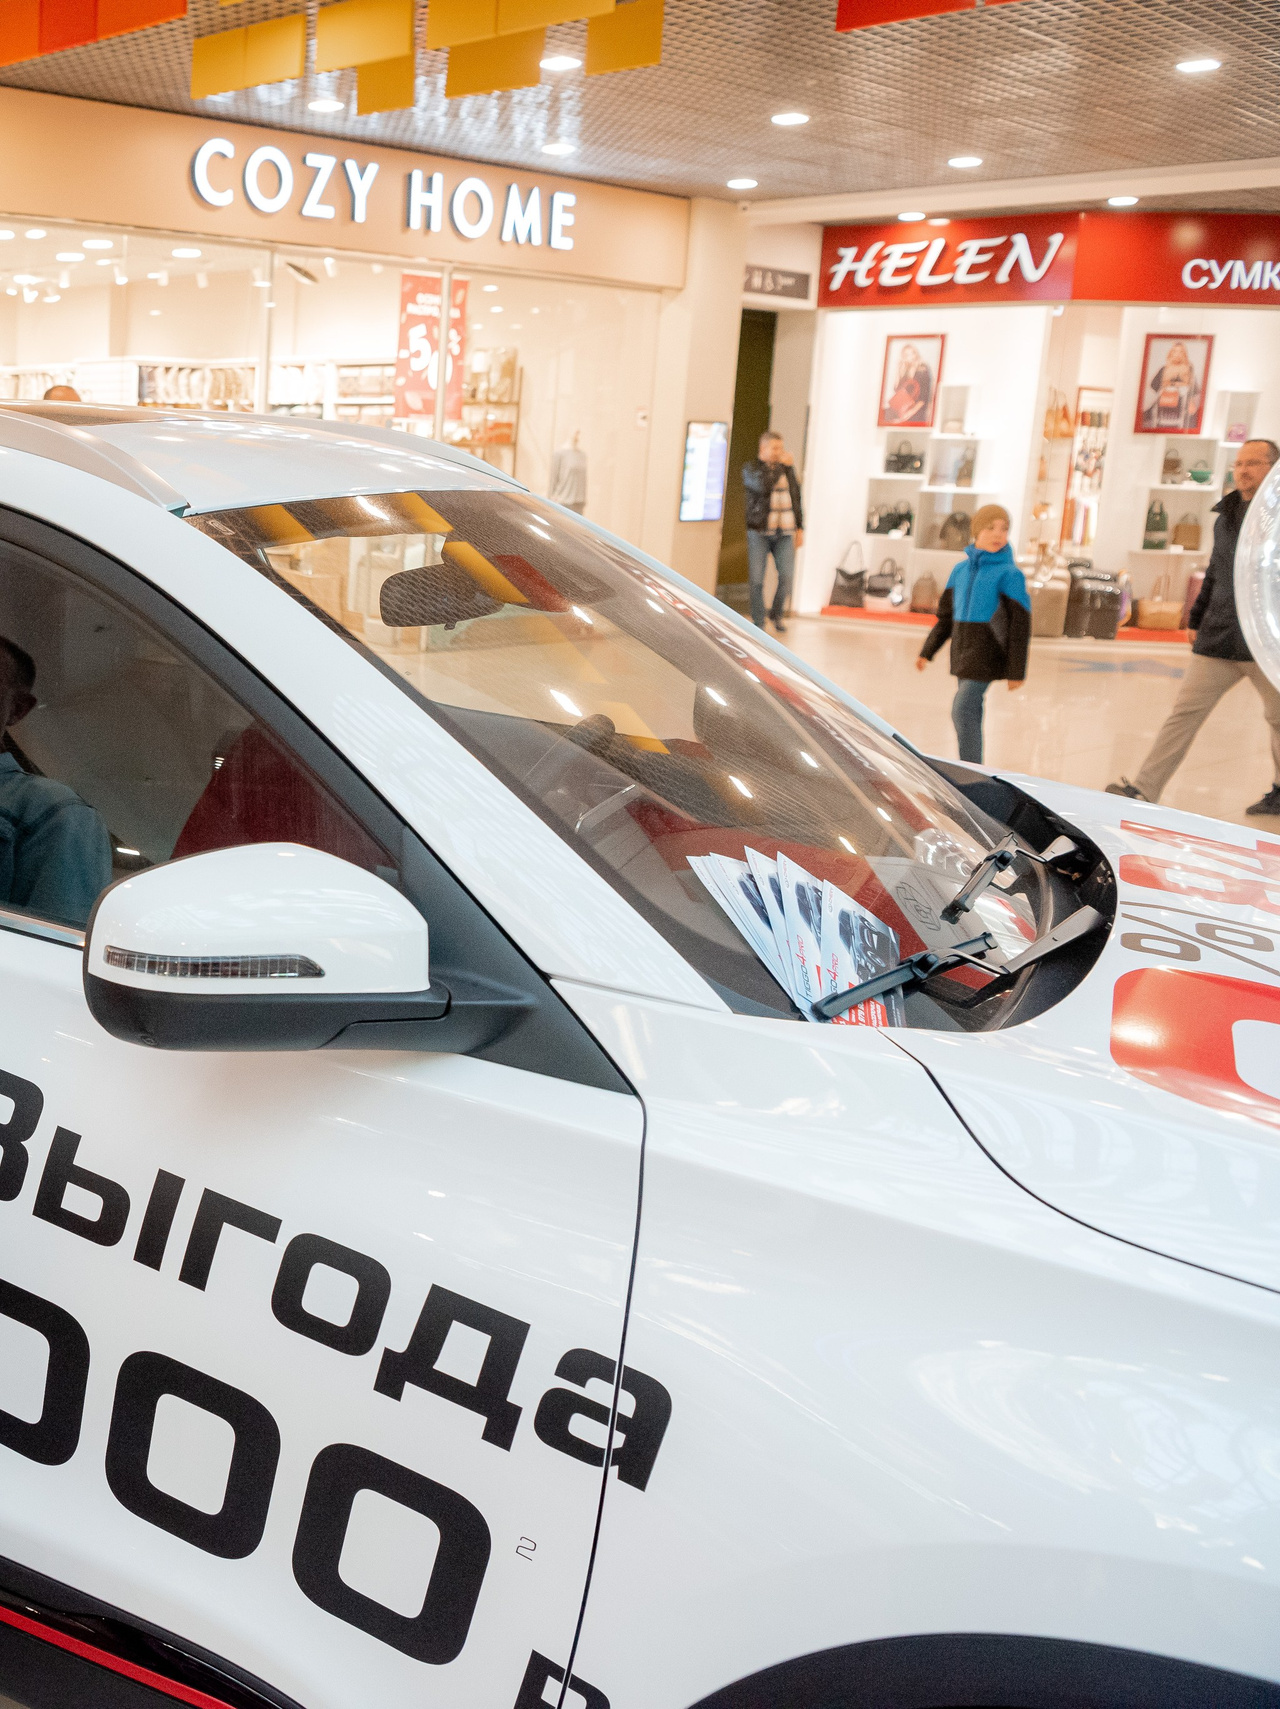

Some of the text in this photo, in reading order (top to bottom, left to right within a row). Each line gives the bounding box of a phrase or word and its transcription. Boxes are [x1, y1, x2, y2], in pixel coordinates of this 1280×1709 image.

[192, 137, 577, 251] COZY HOME
[828, 232, 1065, 292] HELEN
[1181, 258, 1280, 290] СУМК
